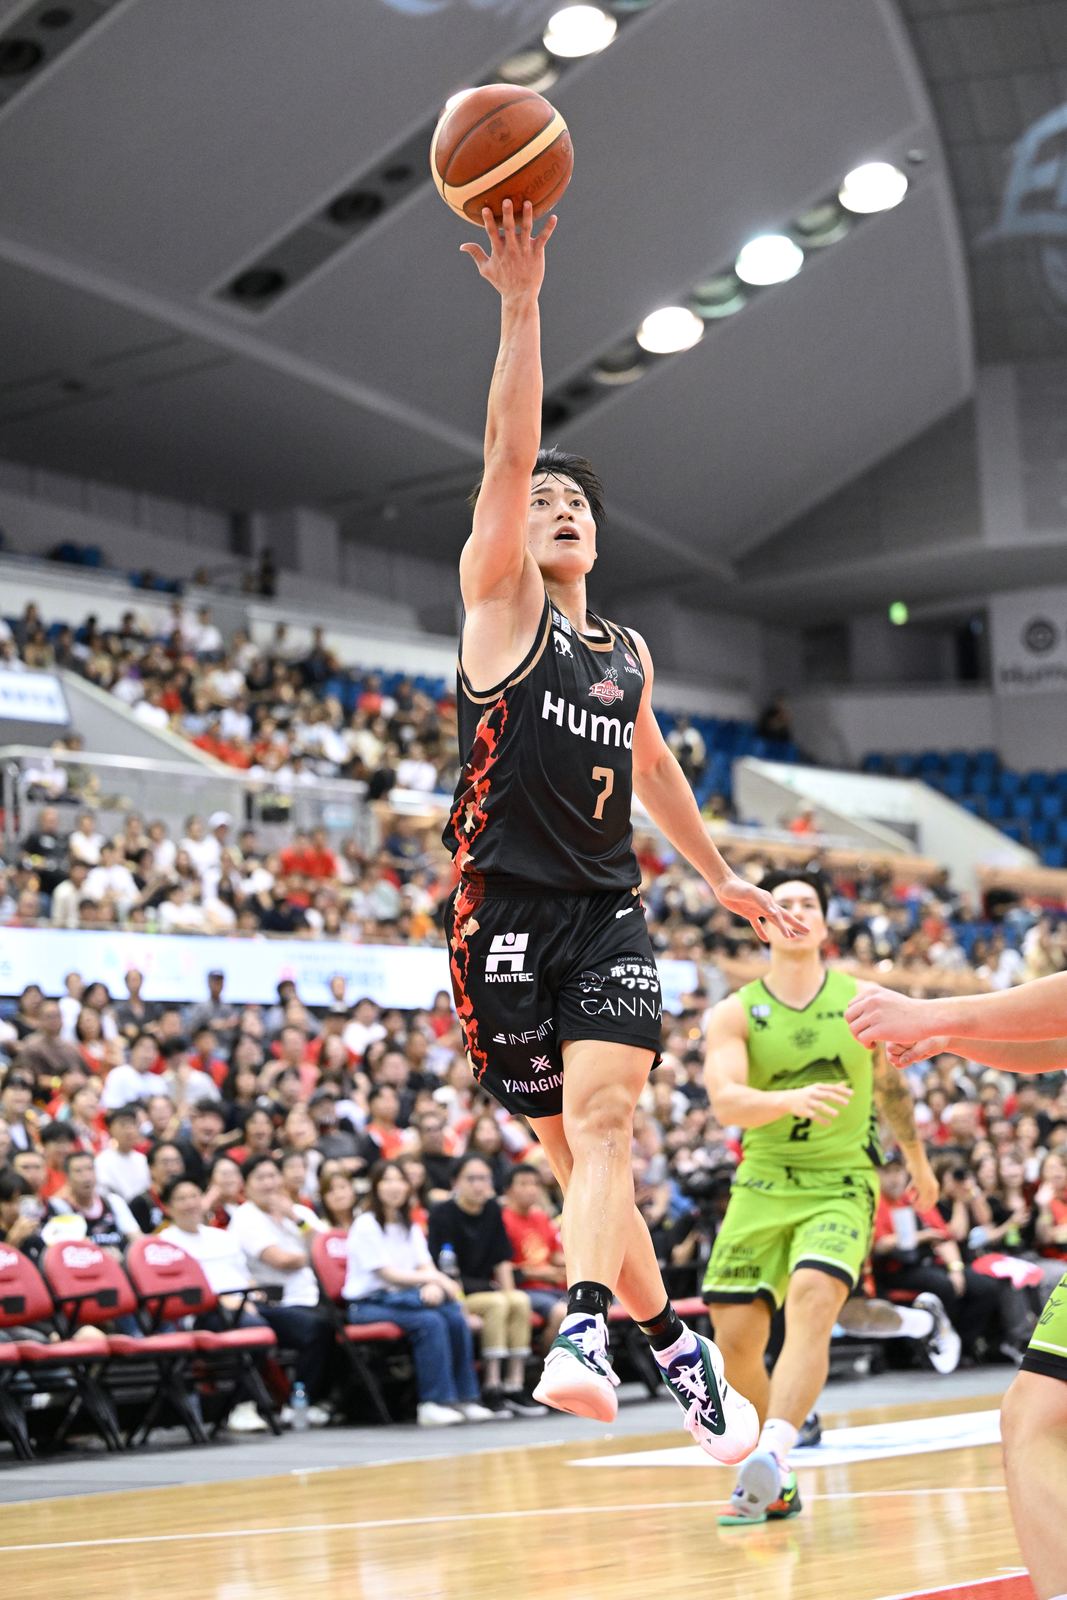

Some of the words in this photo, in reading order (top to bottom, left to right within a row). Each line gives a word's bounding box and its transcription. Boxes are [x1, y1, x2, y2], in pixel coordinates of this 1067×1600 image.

[591, 766, 615, 820] 7
[485, 972, 534, 983] HAMTEC
[789, 1115, 813, 1142] 2
